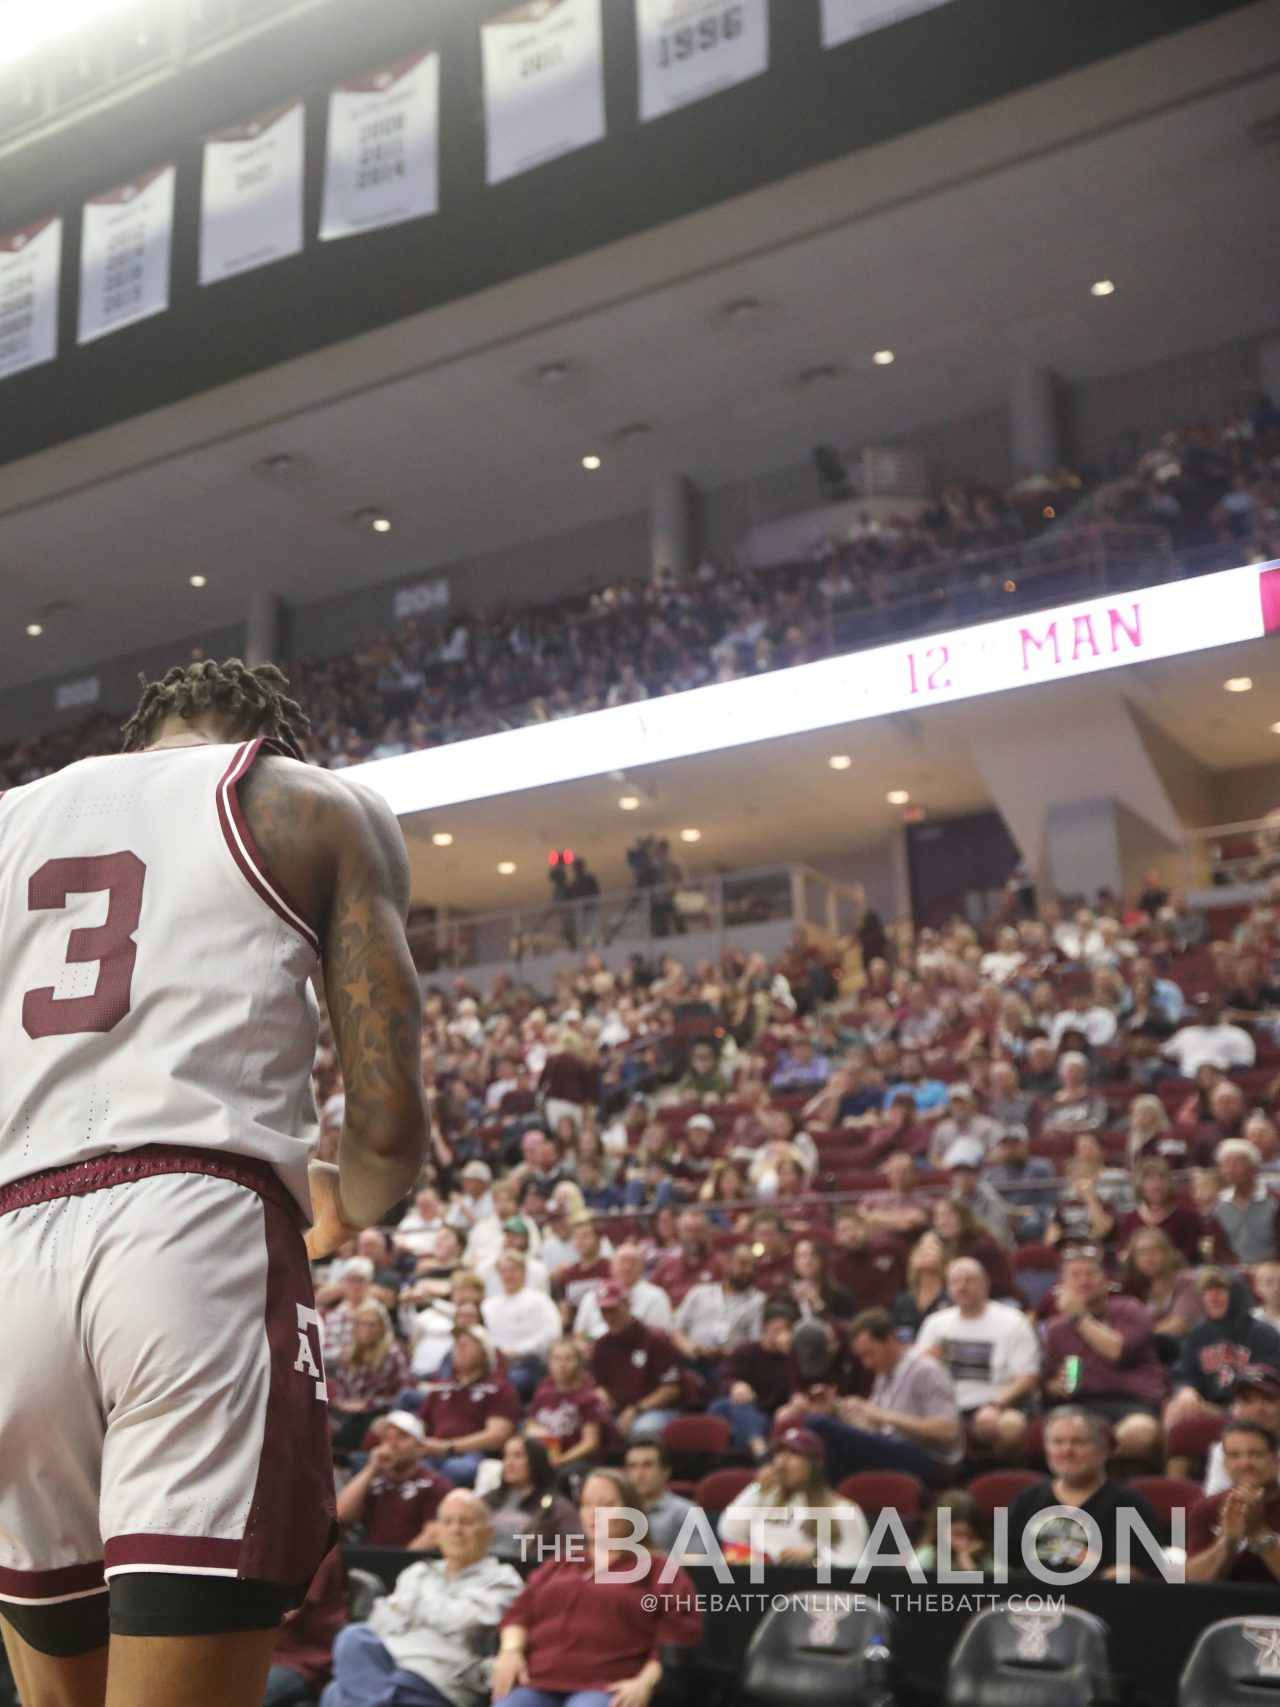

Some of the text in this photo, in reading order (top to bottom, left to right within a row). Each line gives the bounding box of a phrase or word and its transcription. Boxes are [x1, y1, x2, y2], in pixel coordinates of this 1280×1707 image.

[659, 5, 743, 69] 1996
[1019, 603, 1144, 671] MAN
[22, 850, 147, 1040] 3
